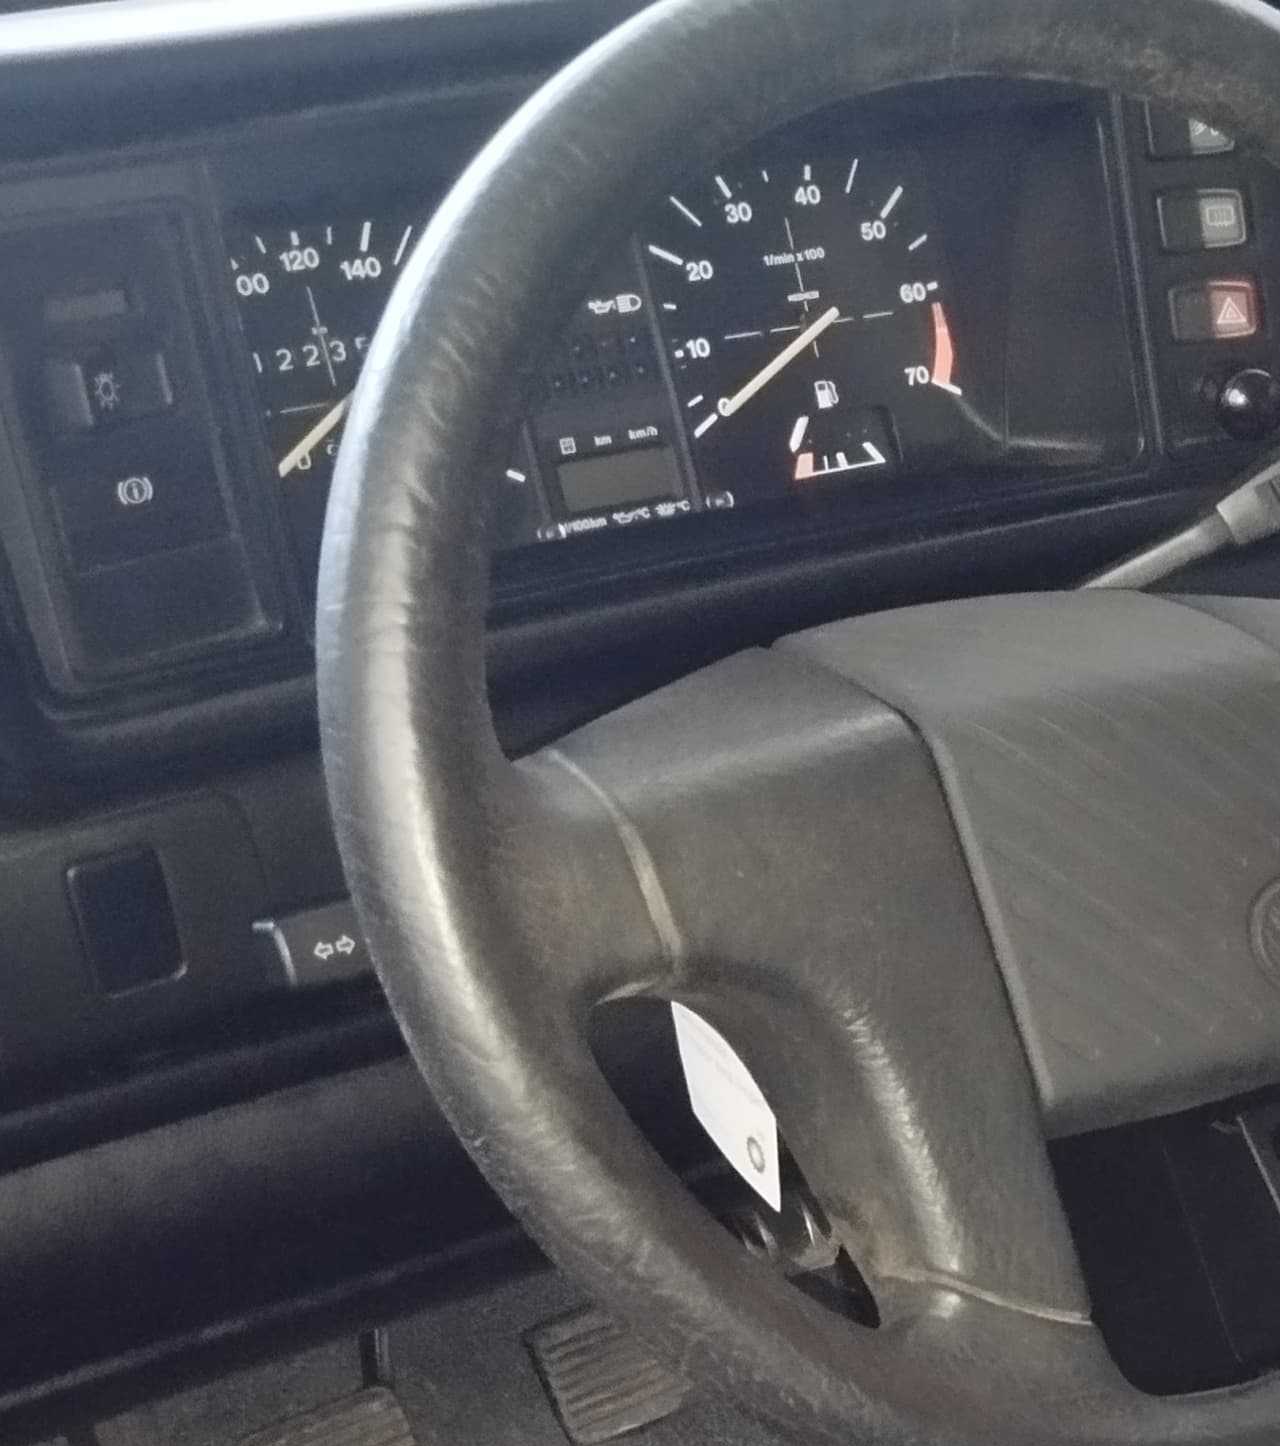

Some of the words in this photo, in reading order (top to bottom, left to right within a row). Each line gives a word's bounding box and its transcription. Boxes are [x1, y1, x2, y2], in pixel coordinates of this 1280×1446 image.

[794, 185, 821, 204] 40
[724, 202, 752, 224] 30
[860, 220, 886, 240] 50
[279, 247, 320, 273] 120
[340, 256, 382, 281] 140
[685, 260, 713, 282] 20
[235, 272, 270, 297] 00
[899, 282, 927, 303] 60
[686, 337, 711, 359] 10
[904, 365, 930, 386] 70
[593, 434, 613, 447] km
[627, 425, 659, 441] km/h
